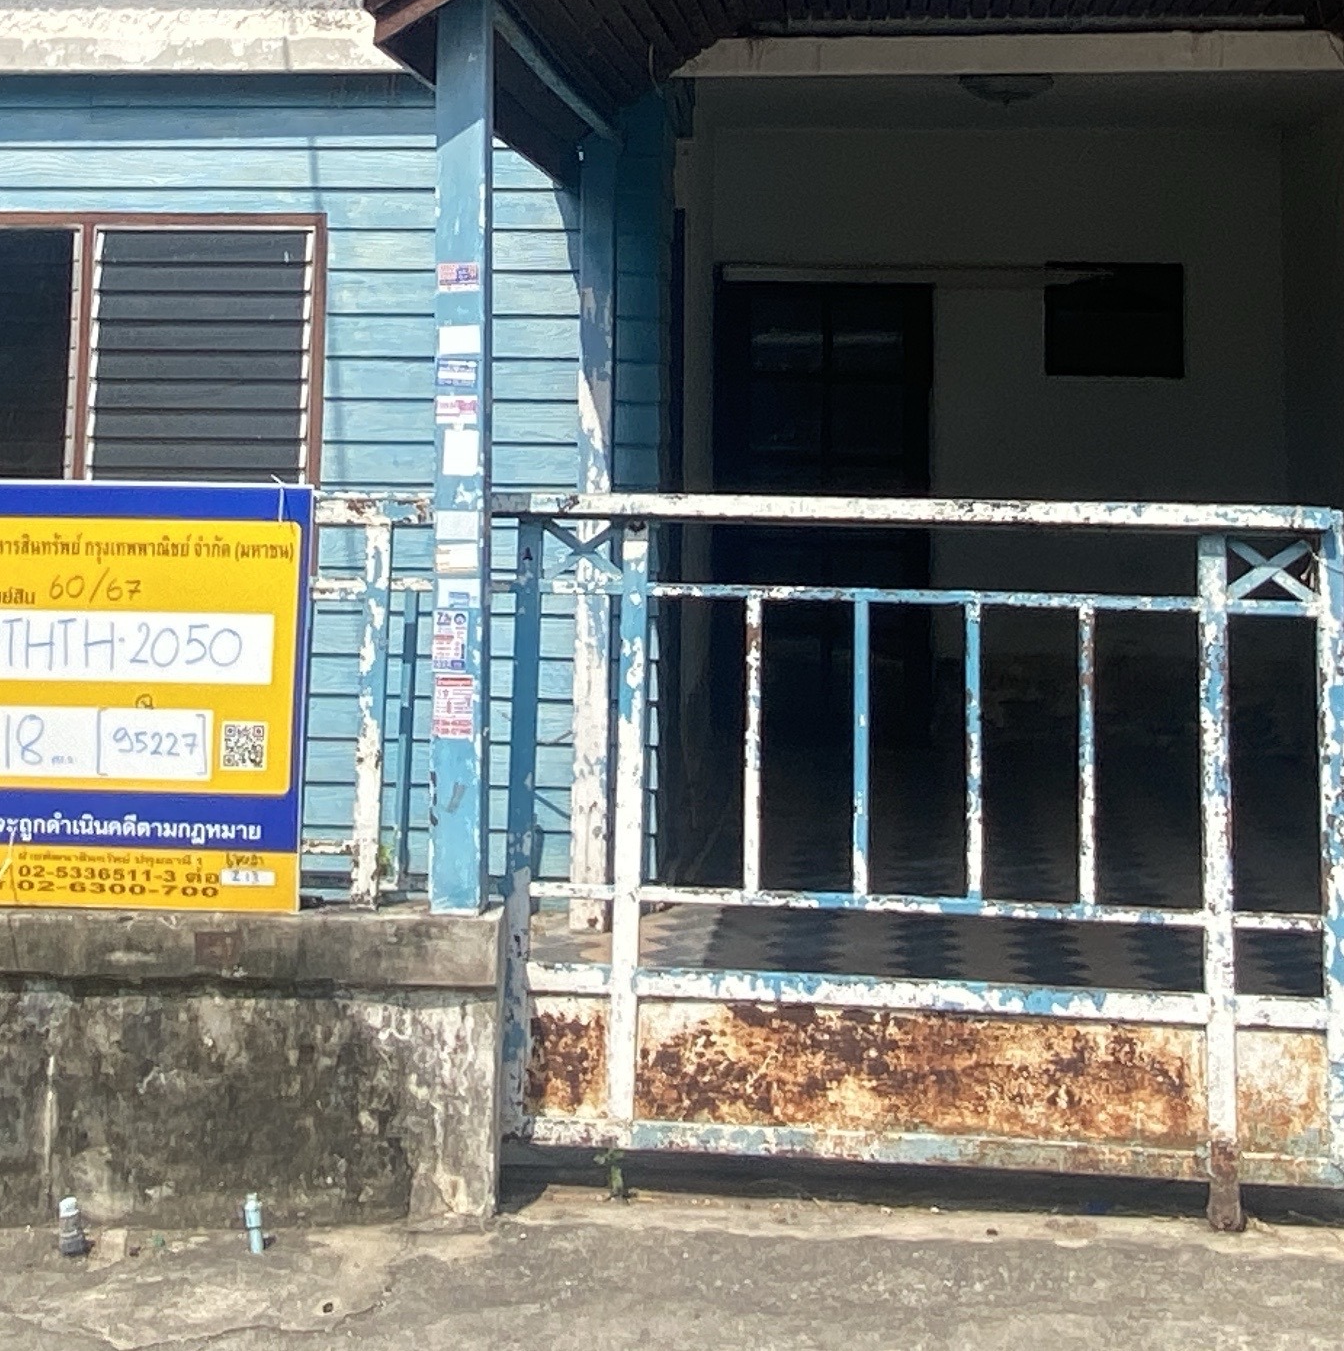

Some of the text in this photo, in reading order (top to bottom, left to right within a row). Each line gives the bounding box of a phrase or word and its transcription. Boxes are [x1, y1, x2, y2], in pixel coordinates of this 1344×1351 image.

[194, 535, 231, 559] จำกัด
[234, 540, 295, 561] (มหาชน)
[49, 567, 143, 603] 60/67
[5, 714, 45, 769] 18
[18, 864, 176, 883] 02-5336511-3
[185, 866, 220, 884] ต่อ
[17, 879, 219, 898] 02-6300-700
